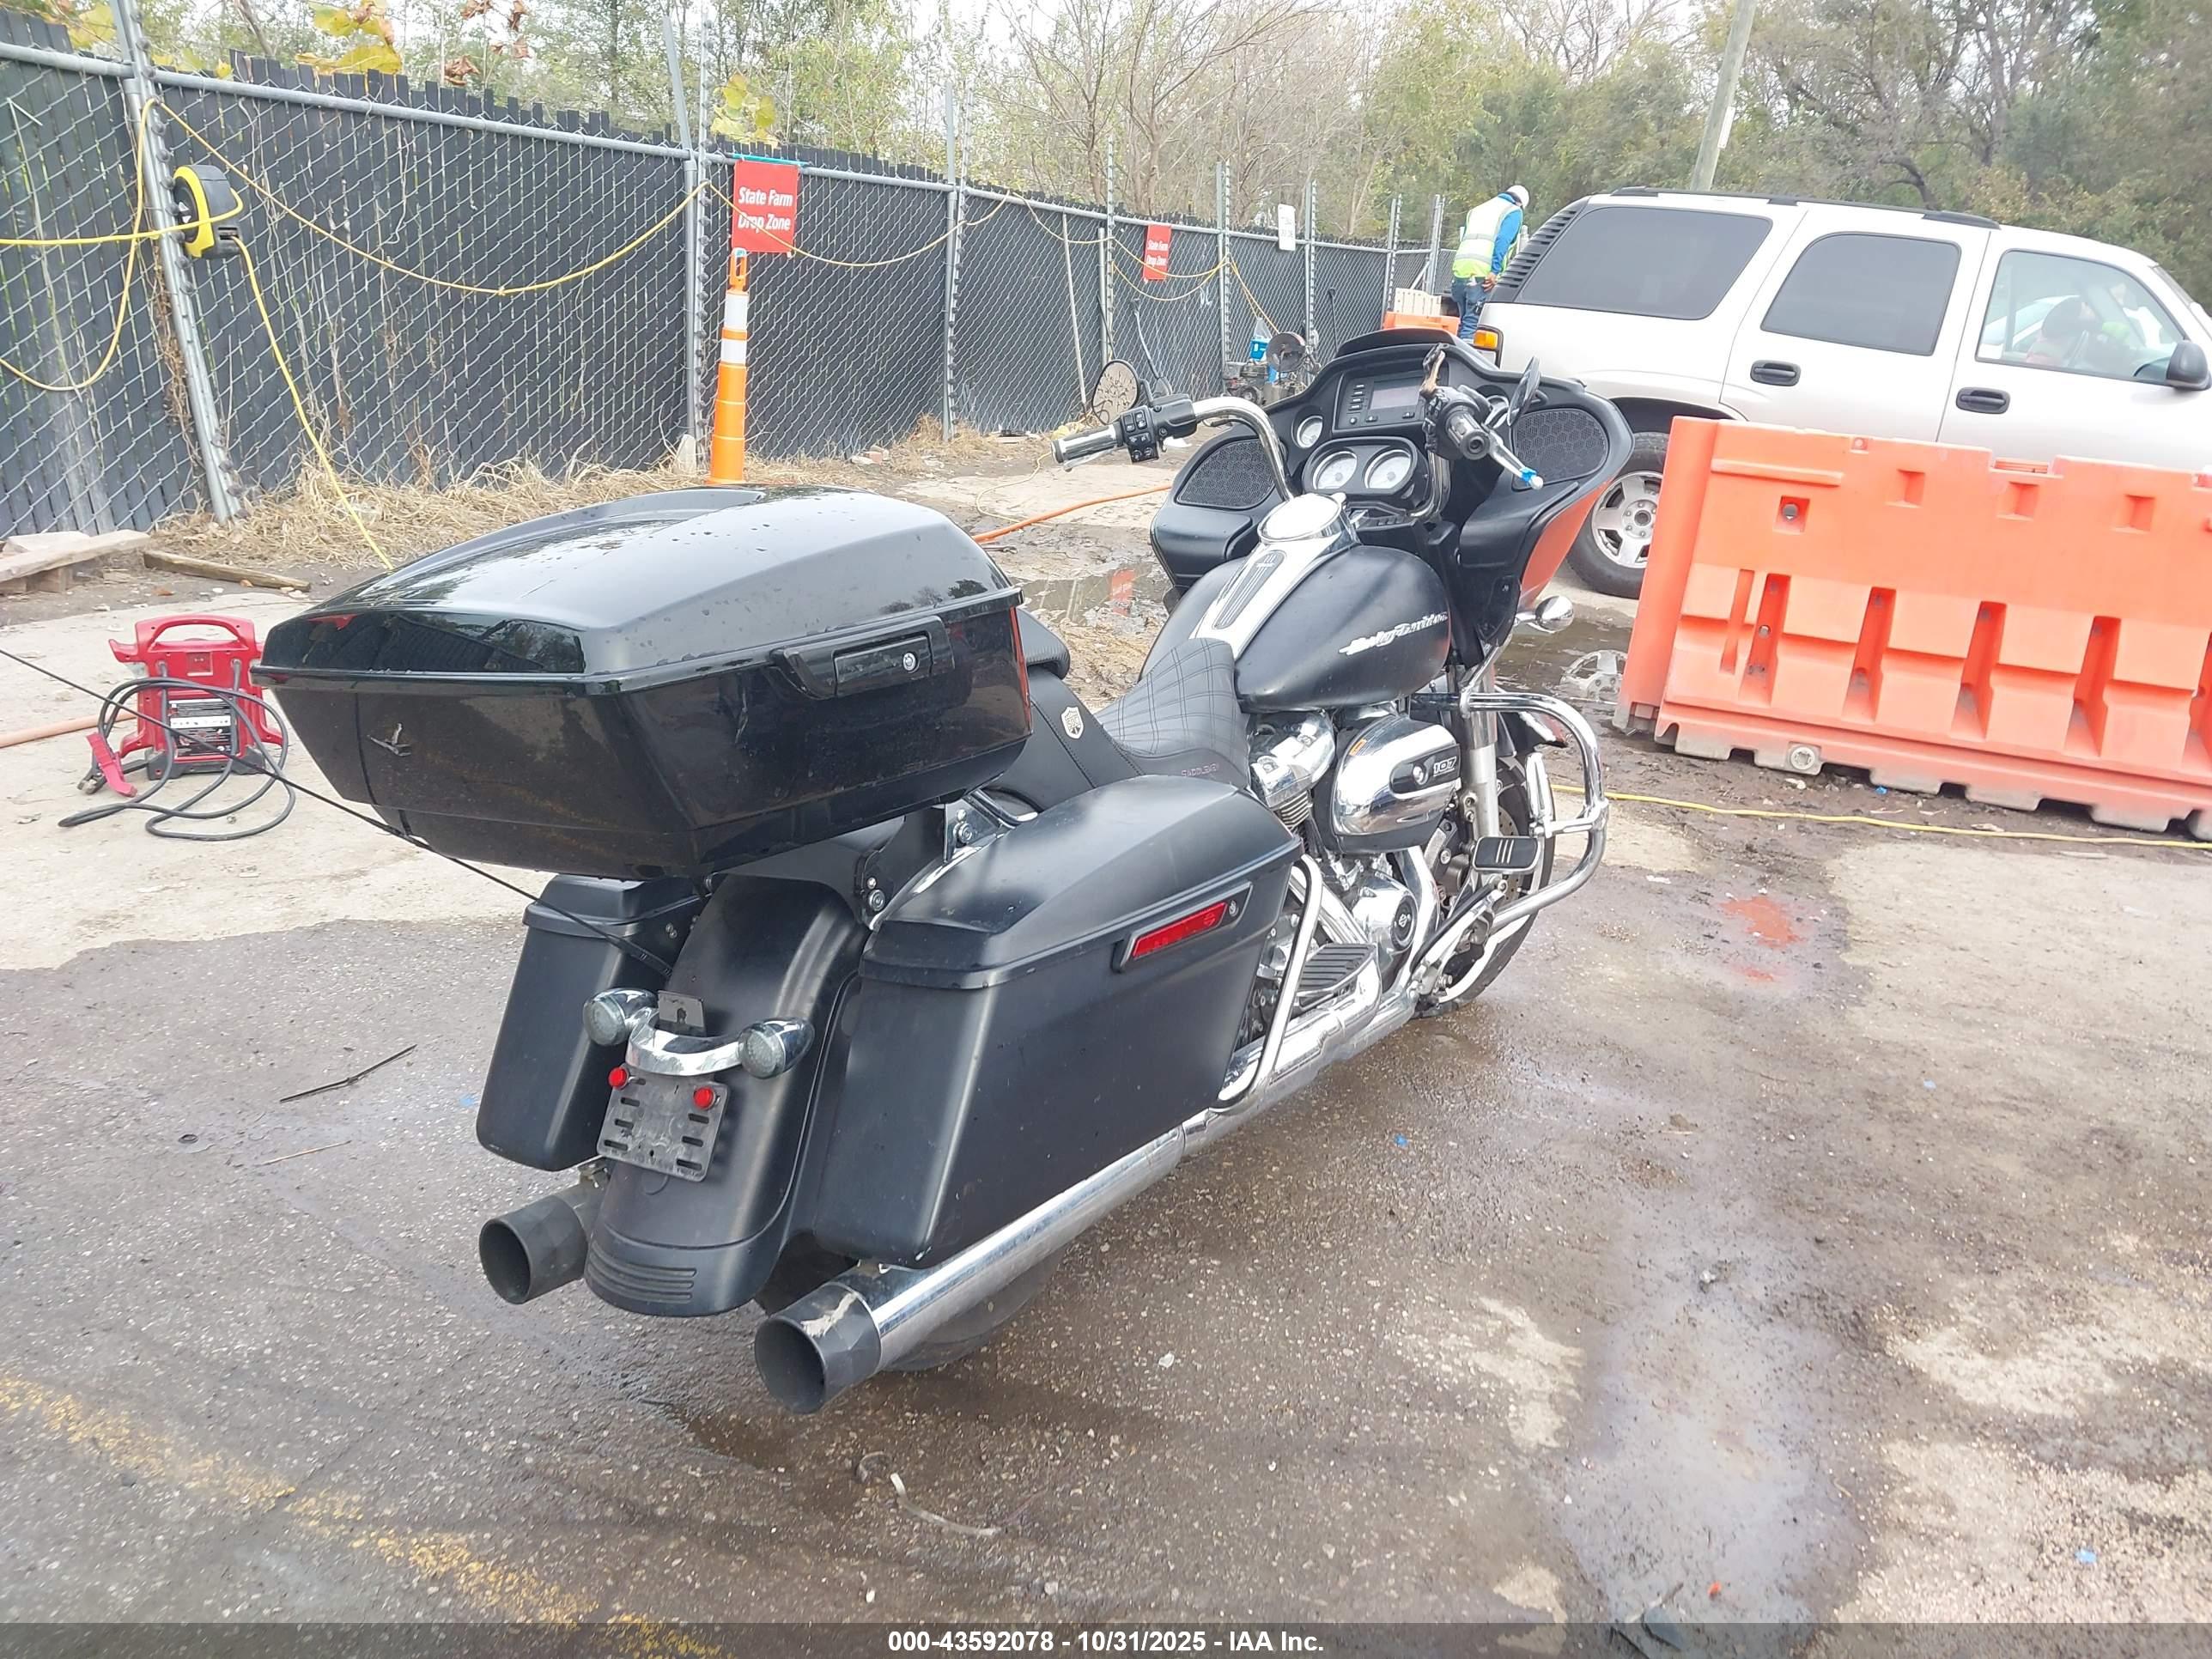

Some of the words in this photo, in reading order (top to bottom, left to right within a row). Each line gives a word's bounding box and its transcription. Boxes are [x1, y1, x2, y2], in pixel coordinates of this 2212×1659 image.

[738, 186, 767, 205] State
[768, 189, 793, 207] Farm
[738, 212, 764, 234] Drop
[765, 213, 791, 231] Zone
[1181, 763, 1219, 776] SADDLEE
[1433, 756, 1457, 775] 107
